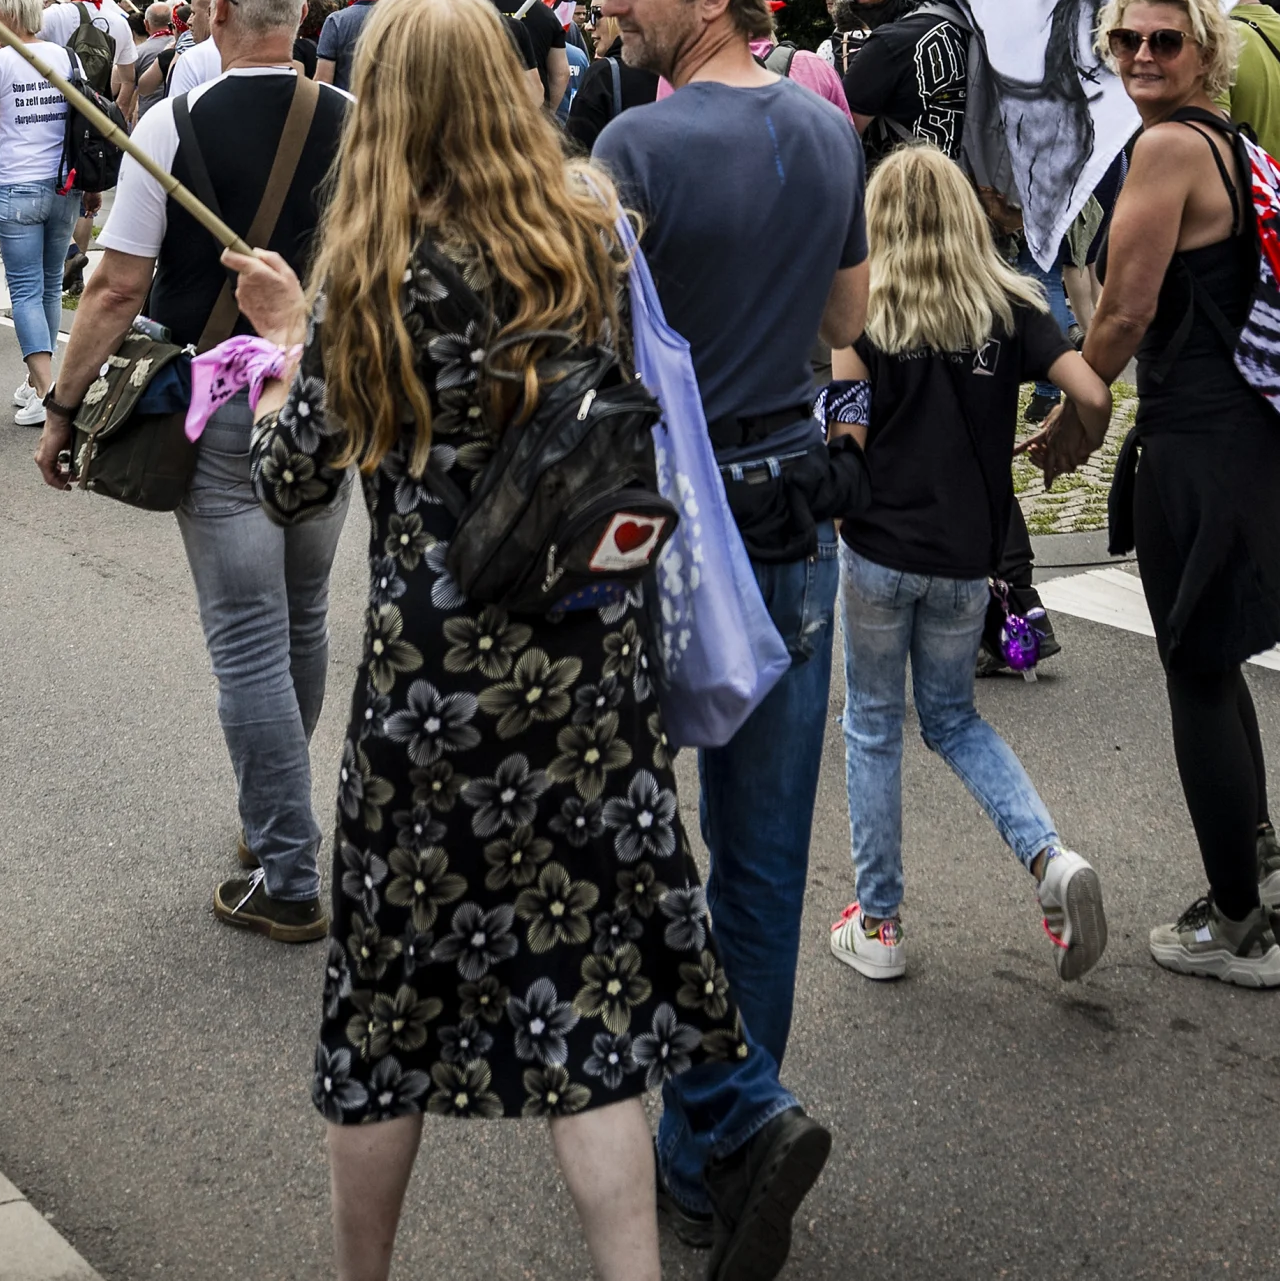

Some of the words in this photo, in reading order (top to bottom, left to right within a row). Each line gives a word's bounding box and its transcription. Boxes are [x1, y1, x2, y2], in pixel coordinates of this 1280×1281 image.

[13, 83, 25, 93] Stop
[15, 98, 25, 107] Ga
[26, 96, 39, 106] zelf
